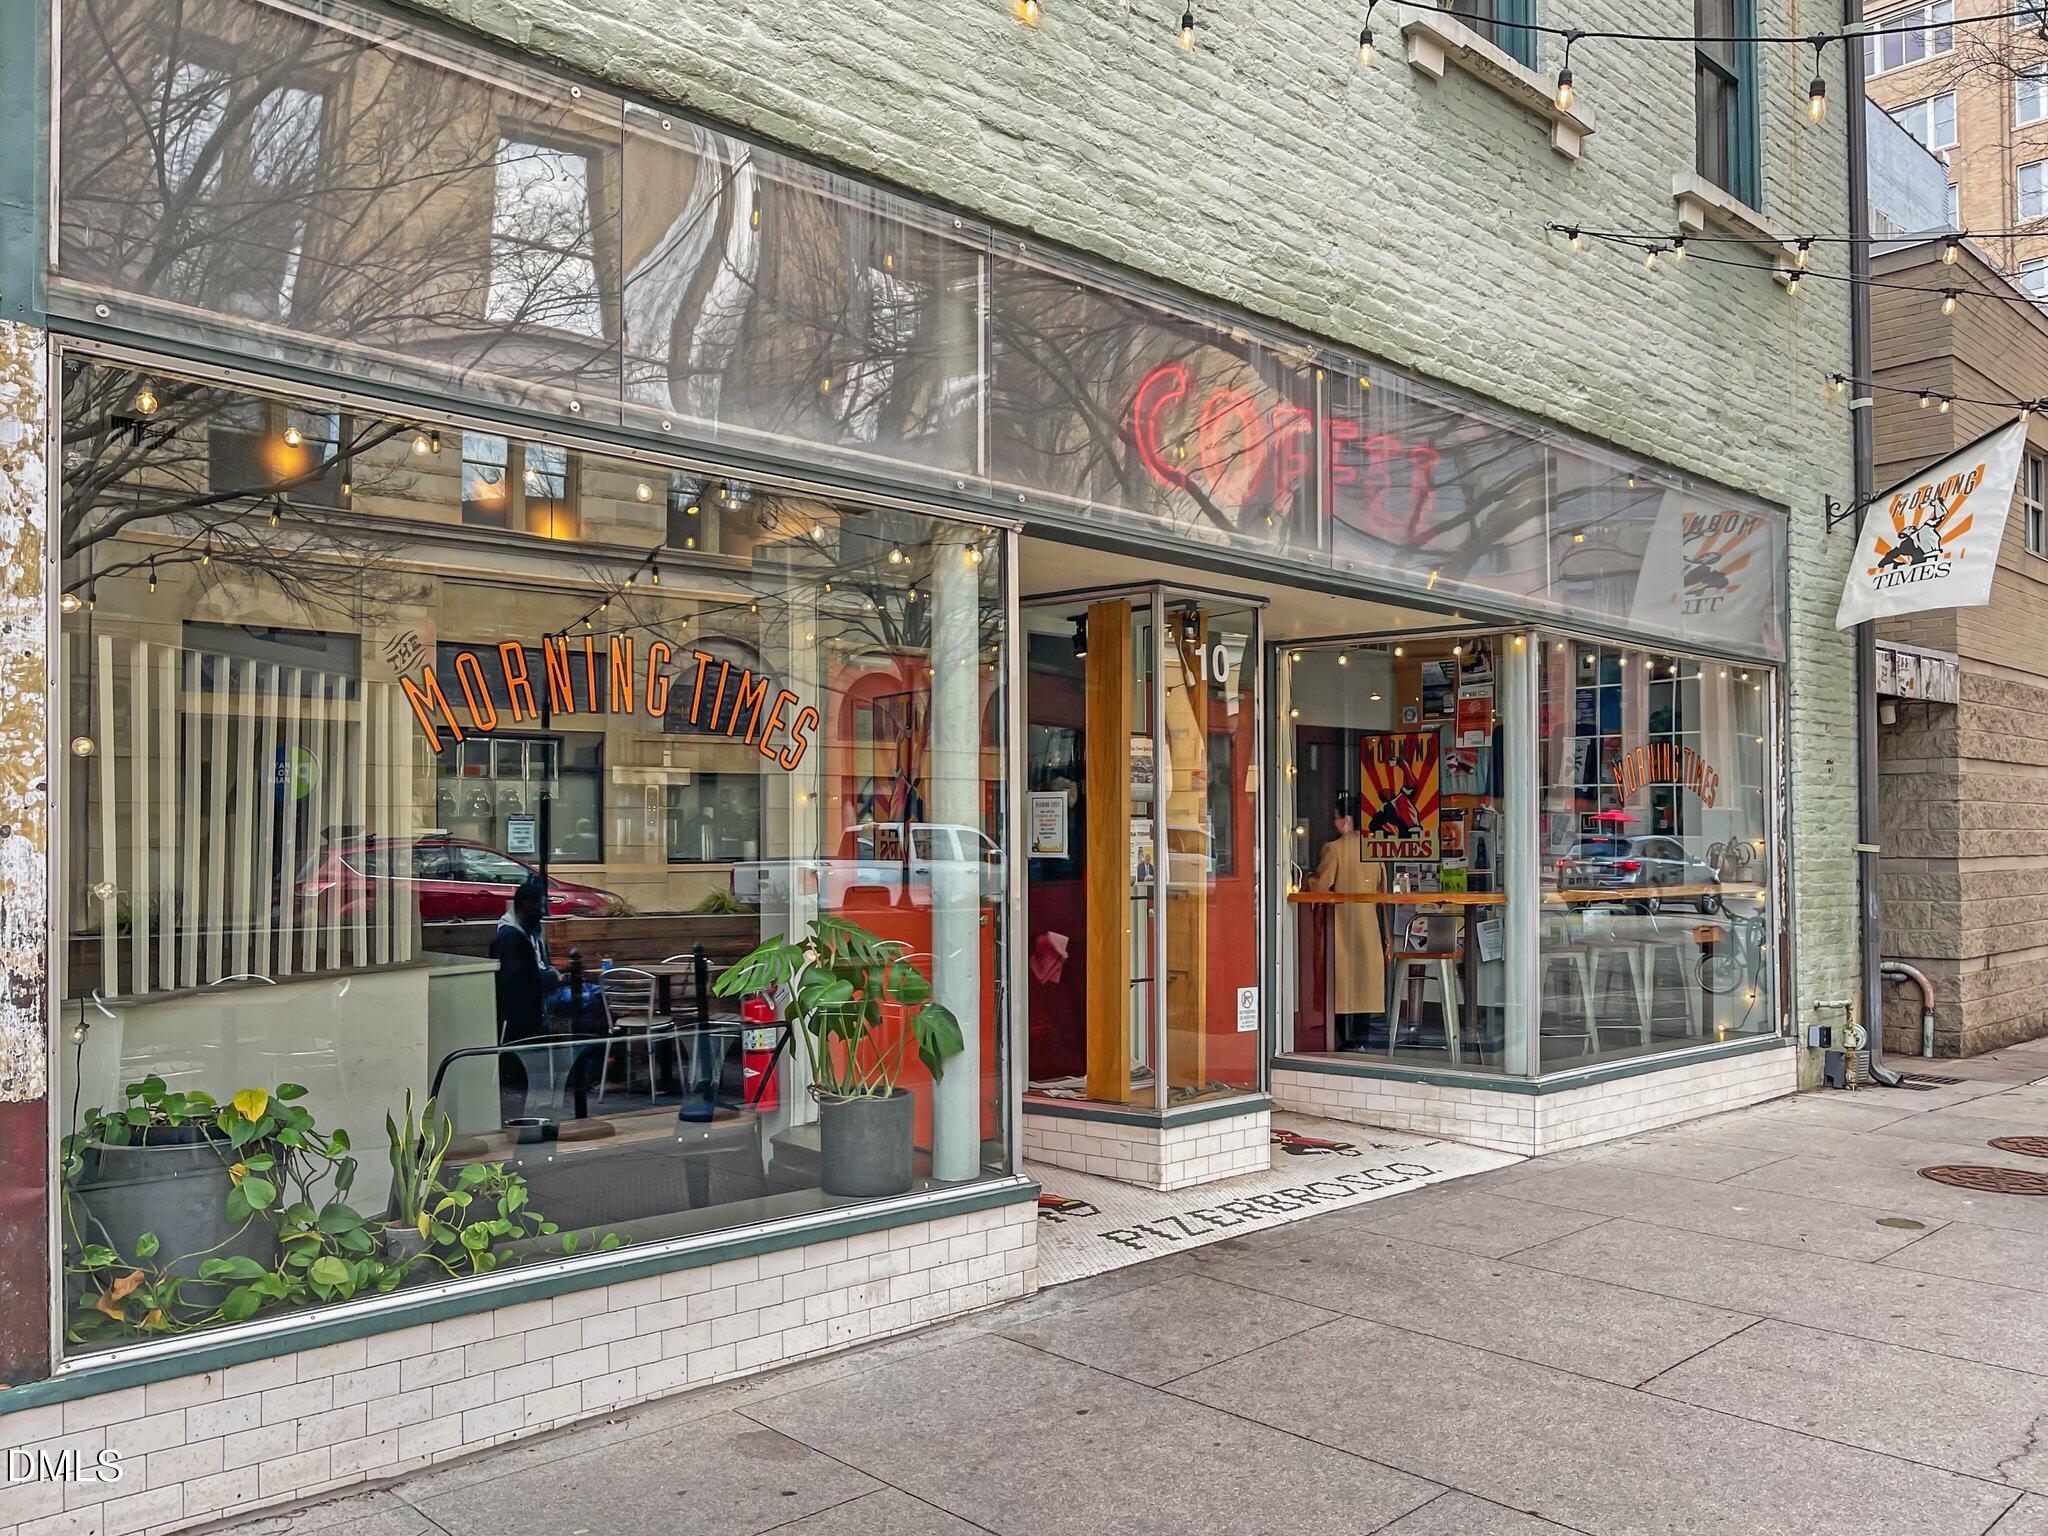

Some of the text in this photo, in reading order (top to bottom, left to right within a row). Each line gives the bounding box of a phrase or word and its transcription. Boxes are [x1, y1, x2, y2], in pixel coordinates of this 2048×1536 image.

[1892, 471, 1978, 518] MORNING
[1872, 562, 1952, 591] TIMES
[386, 634, 423, 671] THE
[1195, 643, 1230, 683] 10
[398, 633, 673, 755] MORNING
[688, 648, 820, 772] TIMES
[1612, 742, 1720, 809] MORNING TIMES
[1367, 840, 1433, 859] TIMES
